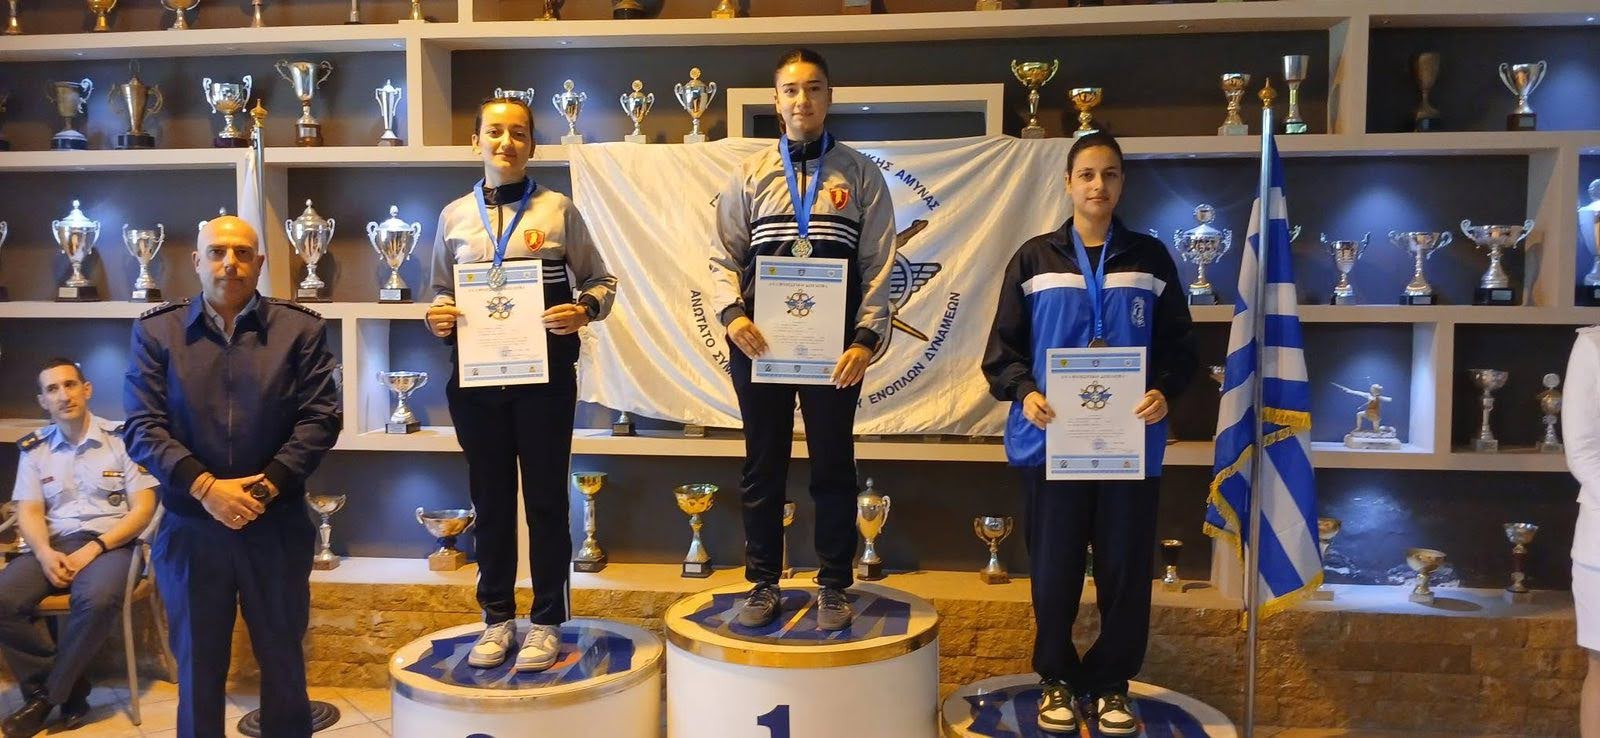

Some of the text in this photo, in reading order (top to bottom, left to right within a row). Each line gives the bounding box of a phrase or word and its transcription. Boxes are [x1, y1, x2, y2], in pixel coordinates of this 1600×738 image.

[894, 169, 940, 211] ΑΜΥΝΑΣ
[690, 289, 716, 348] ΑΝΩΤΑΤΟ
[868, 362, 925, 404] ΕΝΟΠΛΩΝ
[925, 292, 961, 361] ΔΥΝΑΜΕΩΝ
[757, 704, 791, 738] 1
